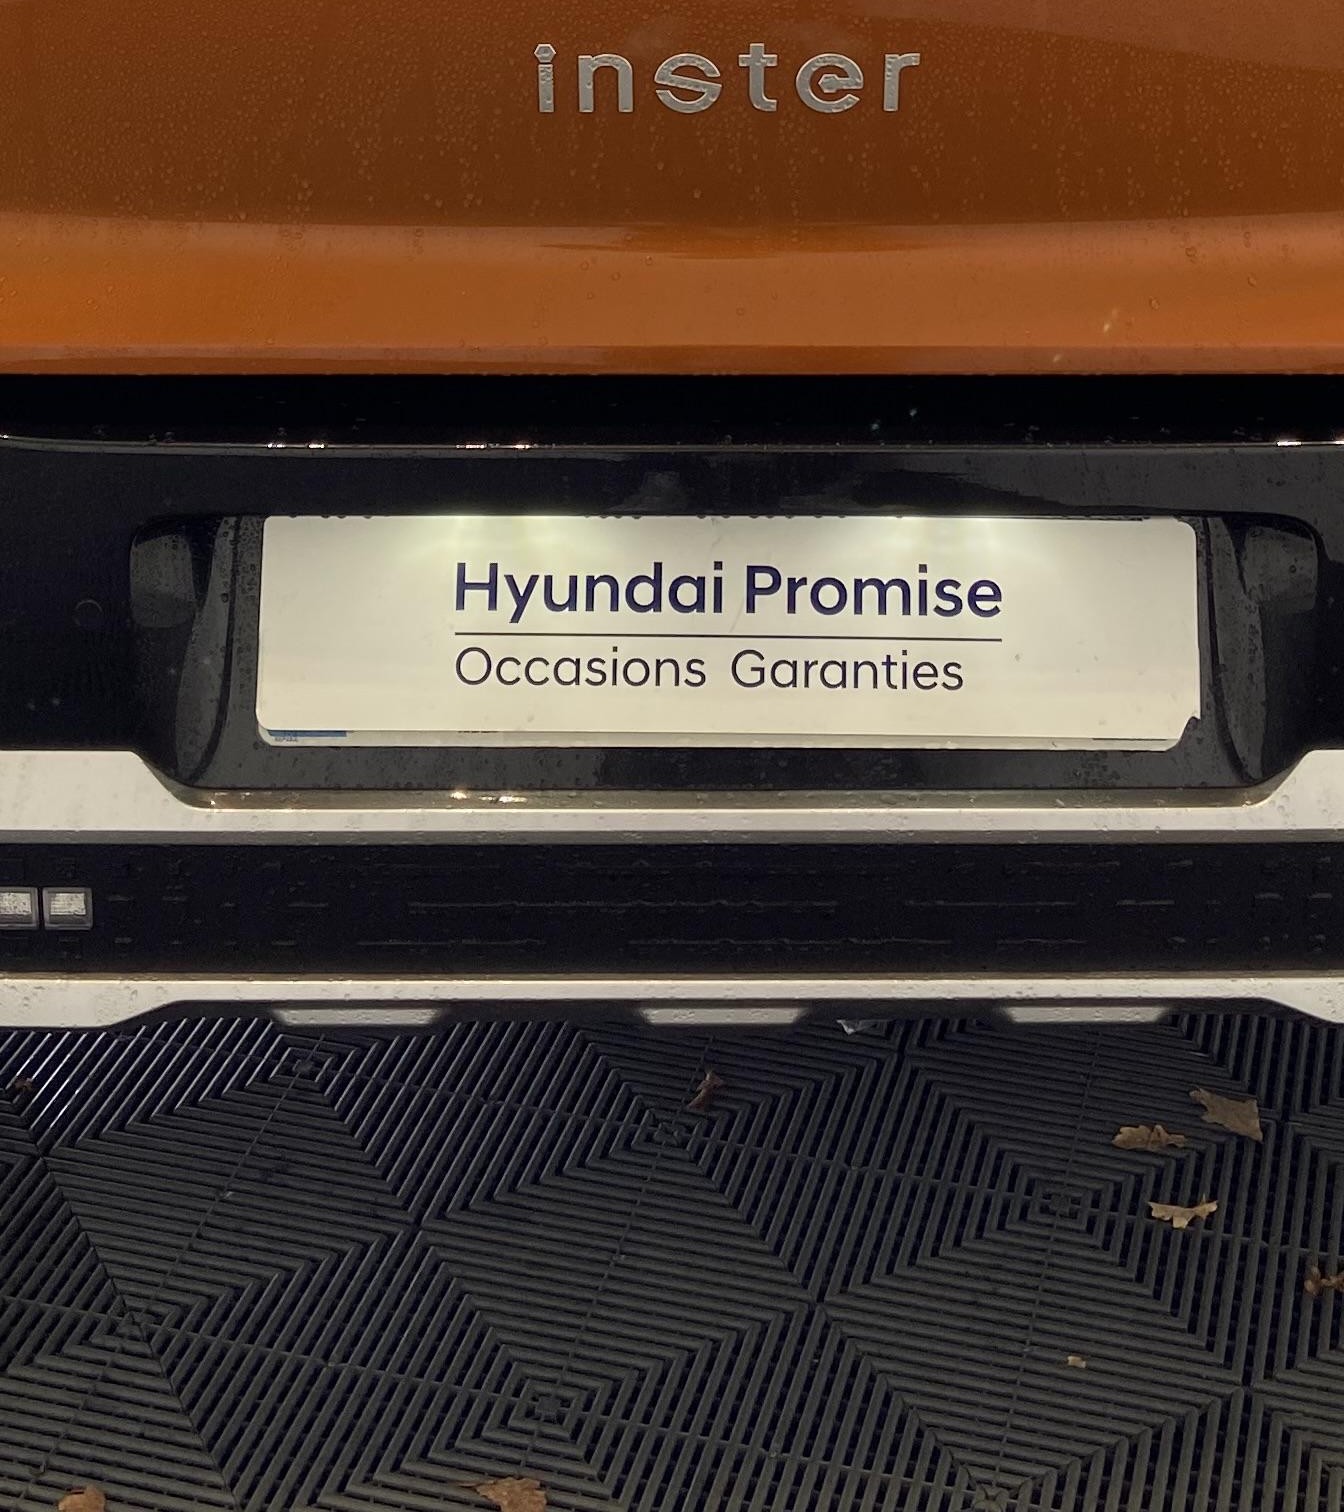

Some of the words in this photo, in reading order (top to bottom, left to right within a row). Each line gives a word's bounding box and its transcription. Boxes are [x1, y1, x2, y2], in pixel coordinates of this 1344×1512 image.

[533, 42, 921, 114] inster
[455, 560, 723, 624] Hyundai
[746, 563, 1002, 618] Promise
[455, 646, 707, 687] Occasions
[731, 649, 964, 691] Garanties
